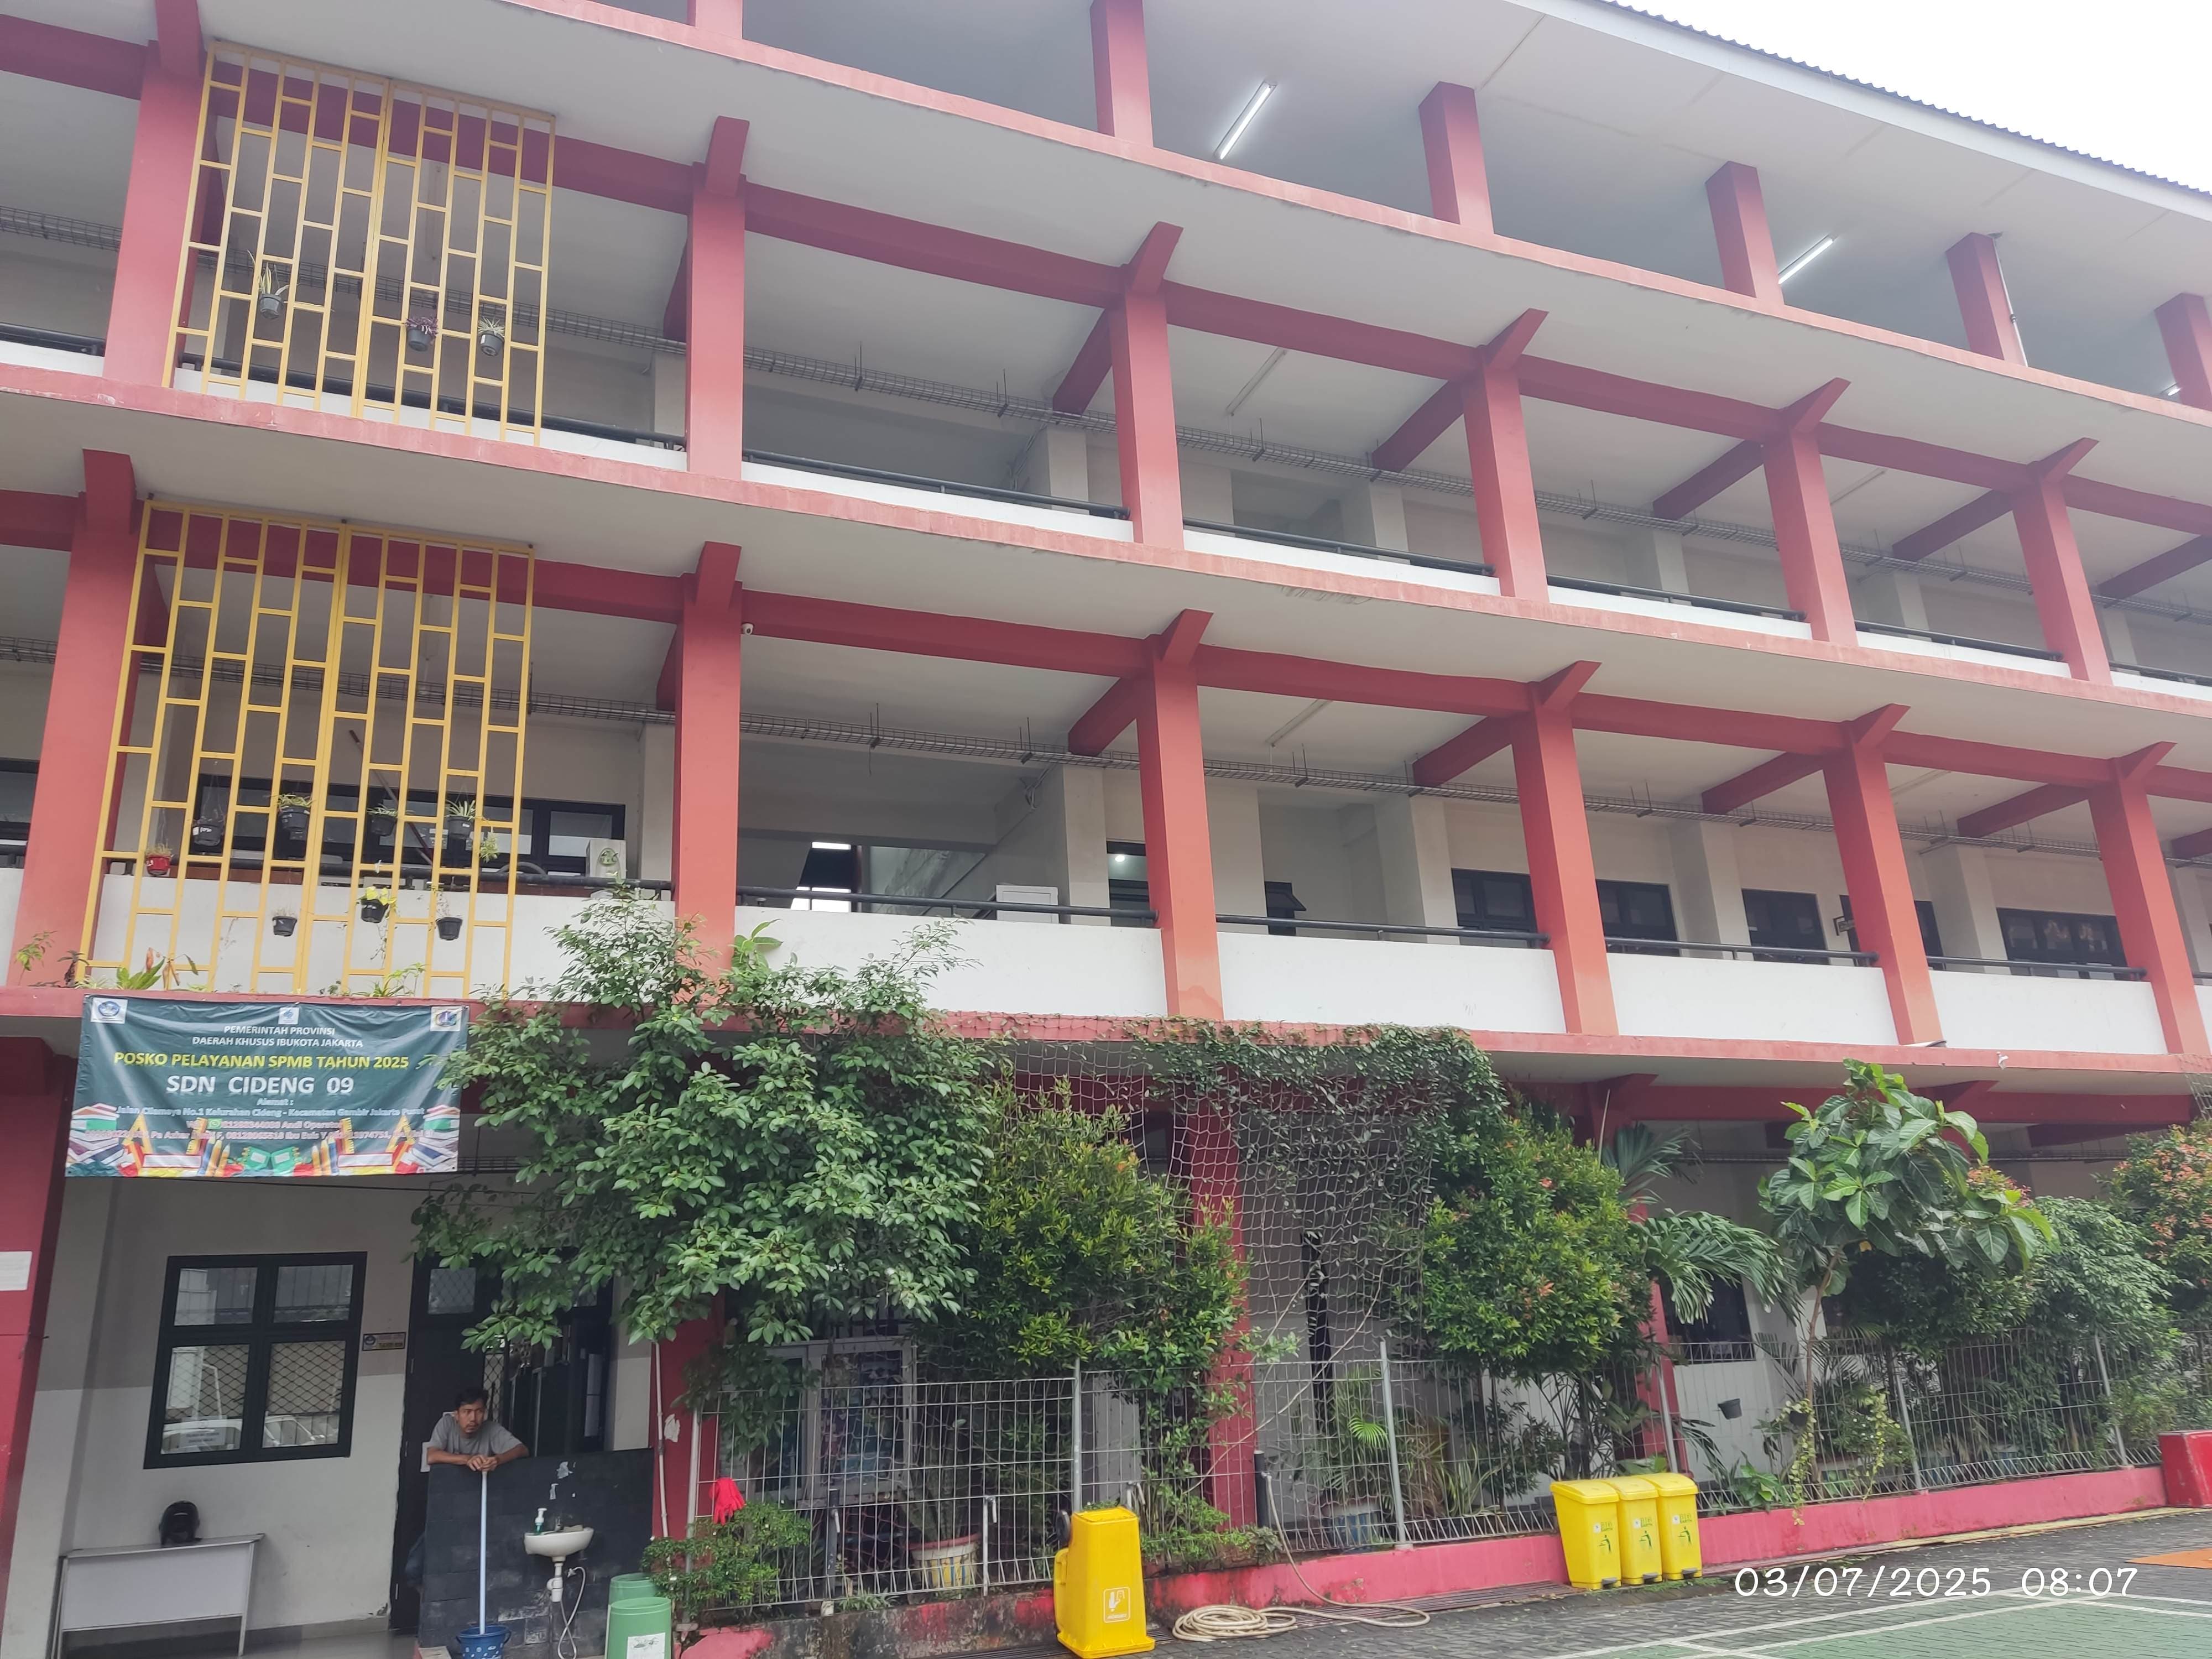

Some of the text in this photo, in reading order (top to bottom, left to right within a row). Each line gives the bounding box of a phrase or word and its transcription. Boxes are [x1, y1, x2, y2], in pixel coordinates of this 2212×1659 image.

[223, 1026, 335, 1036] PEMERINTAH PROVINSI
[192, 1036, 363, 1048] DAERAH KHUSUS IBUKOTA JAKARTA
[113, 1052, 409, 1068] POSKO PELAYANAN SPMB TAHUN 2025
[166, 1075, 354, 1094] SDN CIDENG 09
[252, 1108, 281, 1118] Cideng
